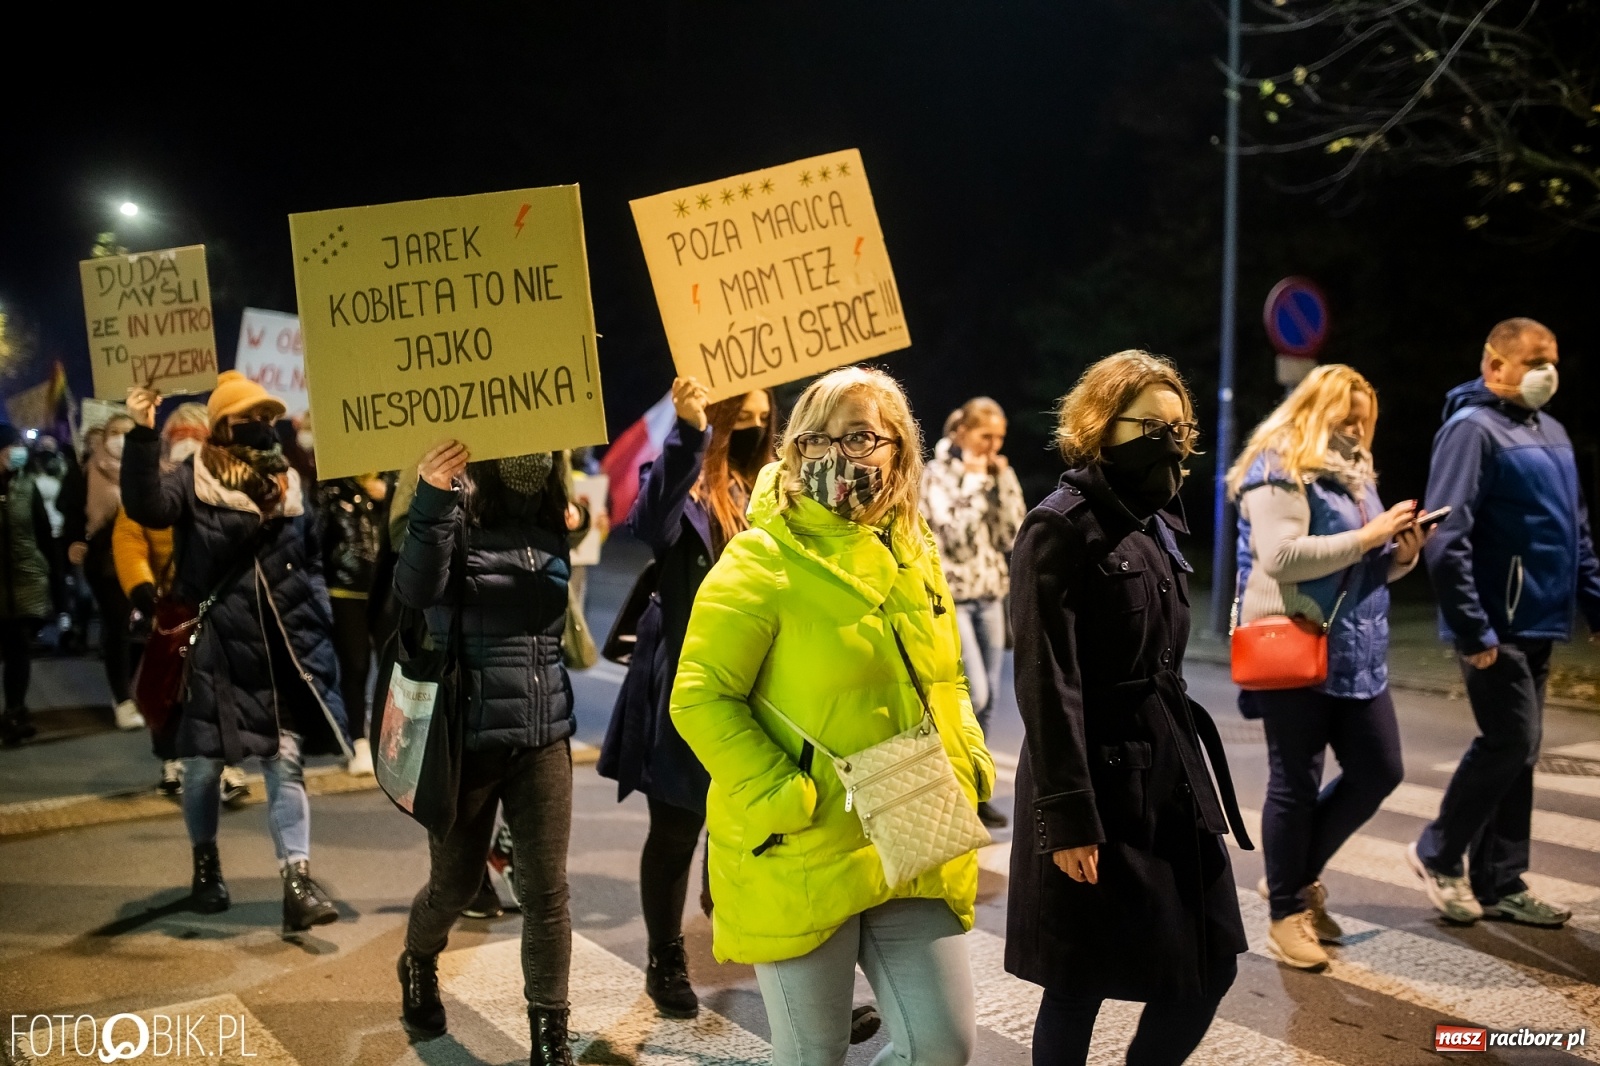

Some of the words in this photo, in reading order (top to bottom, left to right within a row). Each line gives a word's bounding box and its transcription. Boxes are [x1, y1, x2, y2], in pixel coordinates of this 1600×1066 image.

[381, 225, 482, 269] JAREK
[666, 218, 743, 266] POZA
[95, 255, 180, 296] DUDA
[329, 277, 456, 328] KOBIETA
[464, 271, 505, 309] TO
[513, 264, 563, 304] NIE
[719, 263, 784, 316] MAM
[127, 313, 150, 338] IN
[155, 308, 212, 336] VITRO
[101, 344, 129, 367] TO
[130, 348, 216, 384] PIZZERIA
[393, 327, 493, 372] JAJKO
[699, 321, 783, 388] MÓZG
[783, 315, 799, 363] I
